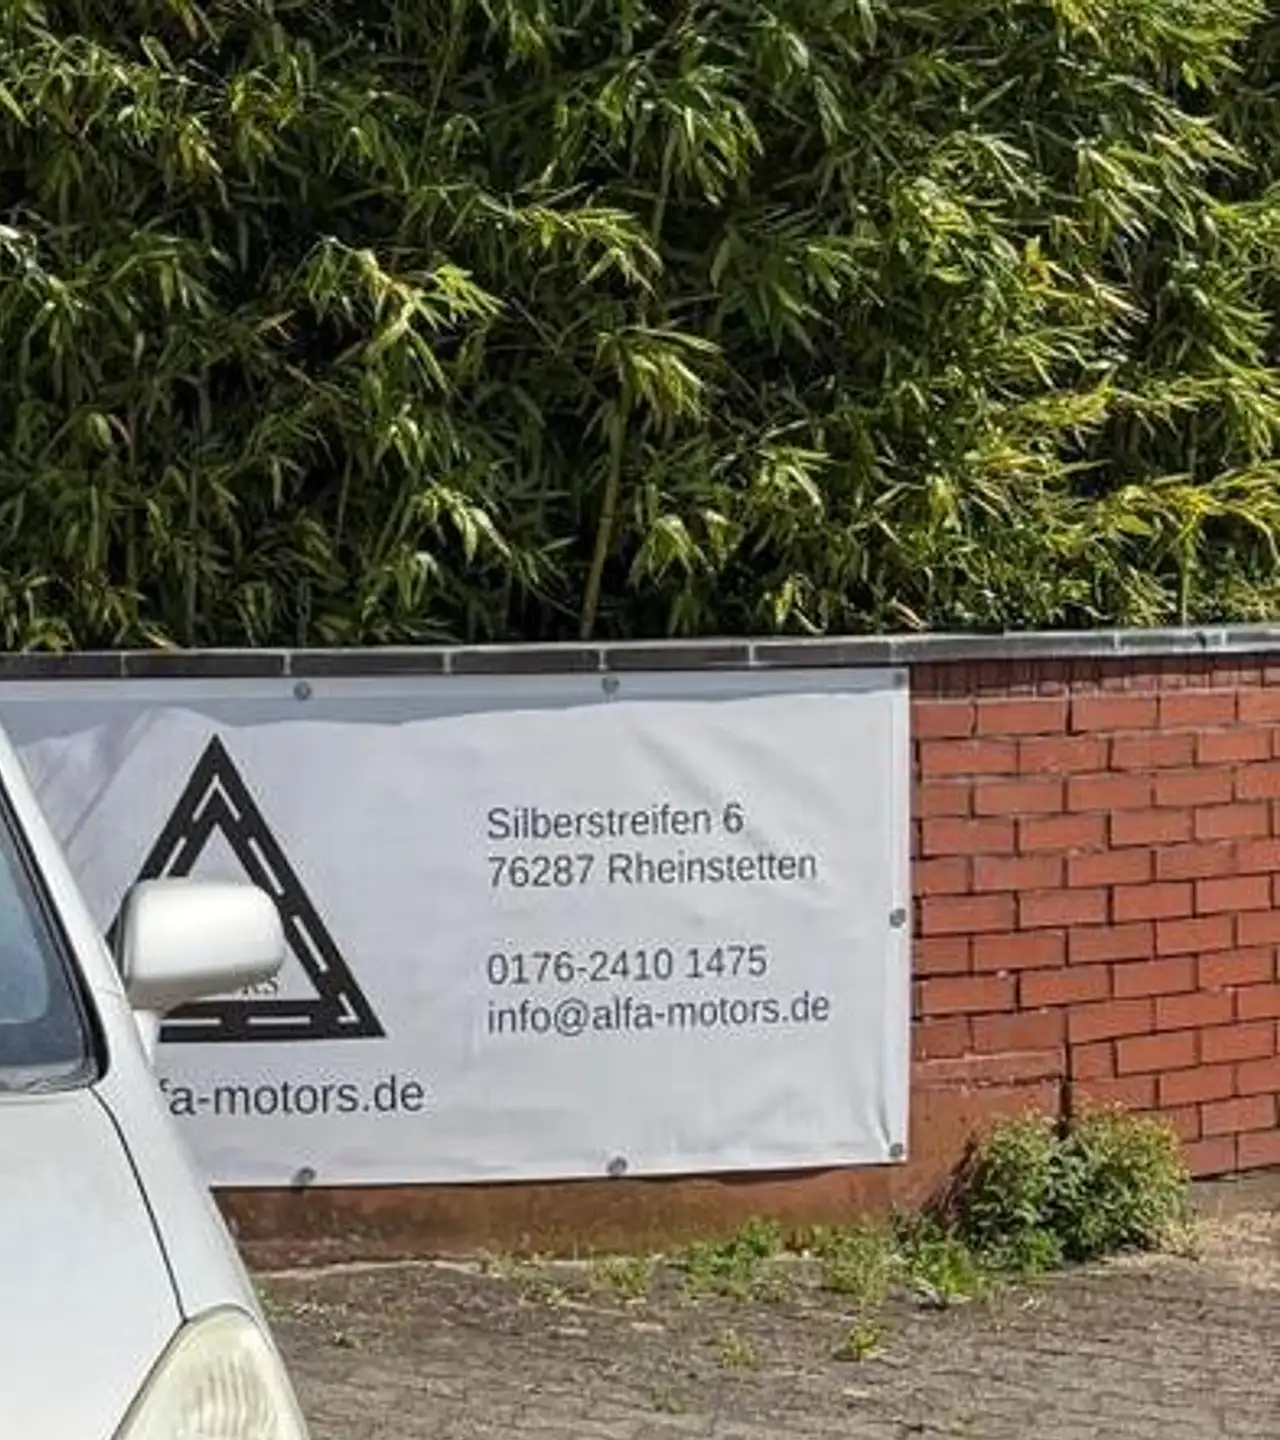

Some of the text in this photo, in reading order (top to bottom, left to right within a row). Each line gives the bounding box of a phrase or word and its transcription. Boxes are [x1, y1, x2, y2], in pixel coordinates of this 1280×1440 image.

[487, 803, 745, 840] Silberstreifen 6
[487, 850, 817, 888] 76287 Rheinstetten
[486, 945, 768, 985] 0176-2410 1475
[488, 990, 830, 1037] info@alfa-motors.de
